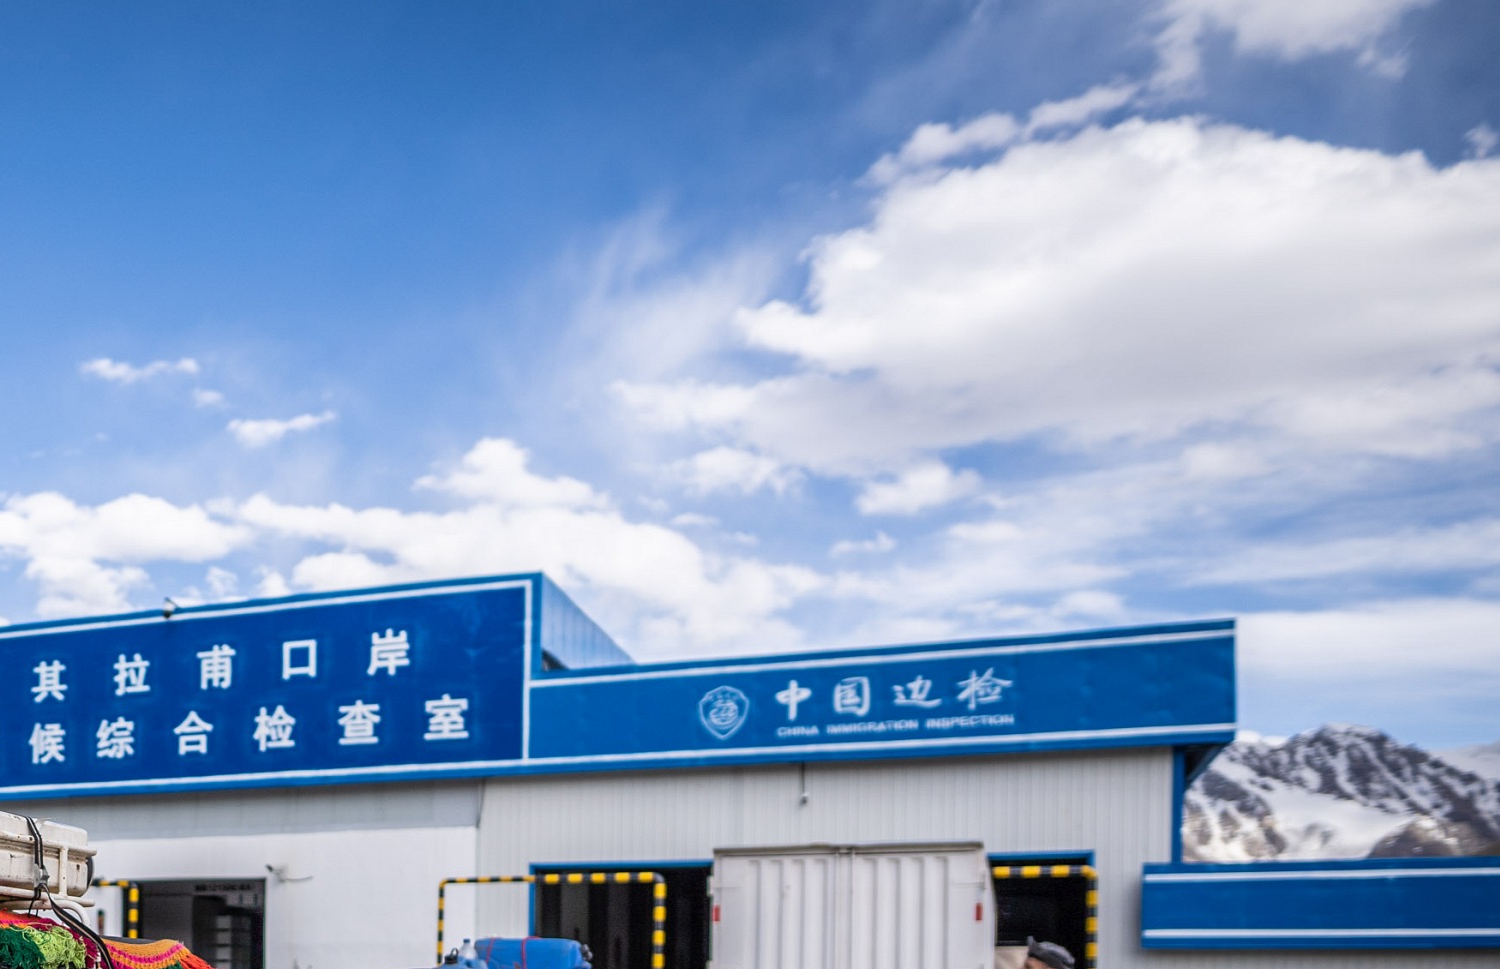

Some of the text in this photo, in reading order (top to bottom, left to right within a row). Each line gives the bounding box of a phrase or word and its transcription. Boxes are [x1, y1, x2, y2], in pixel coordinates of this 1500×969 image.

[775, 667, 1013, 721] 中国边检
[777, 714, 1015, 737] CHINA IMMIGRATION INSPECTION
